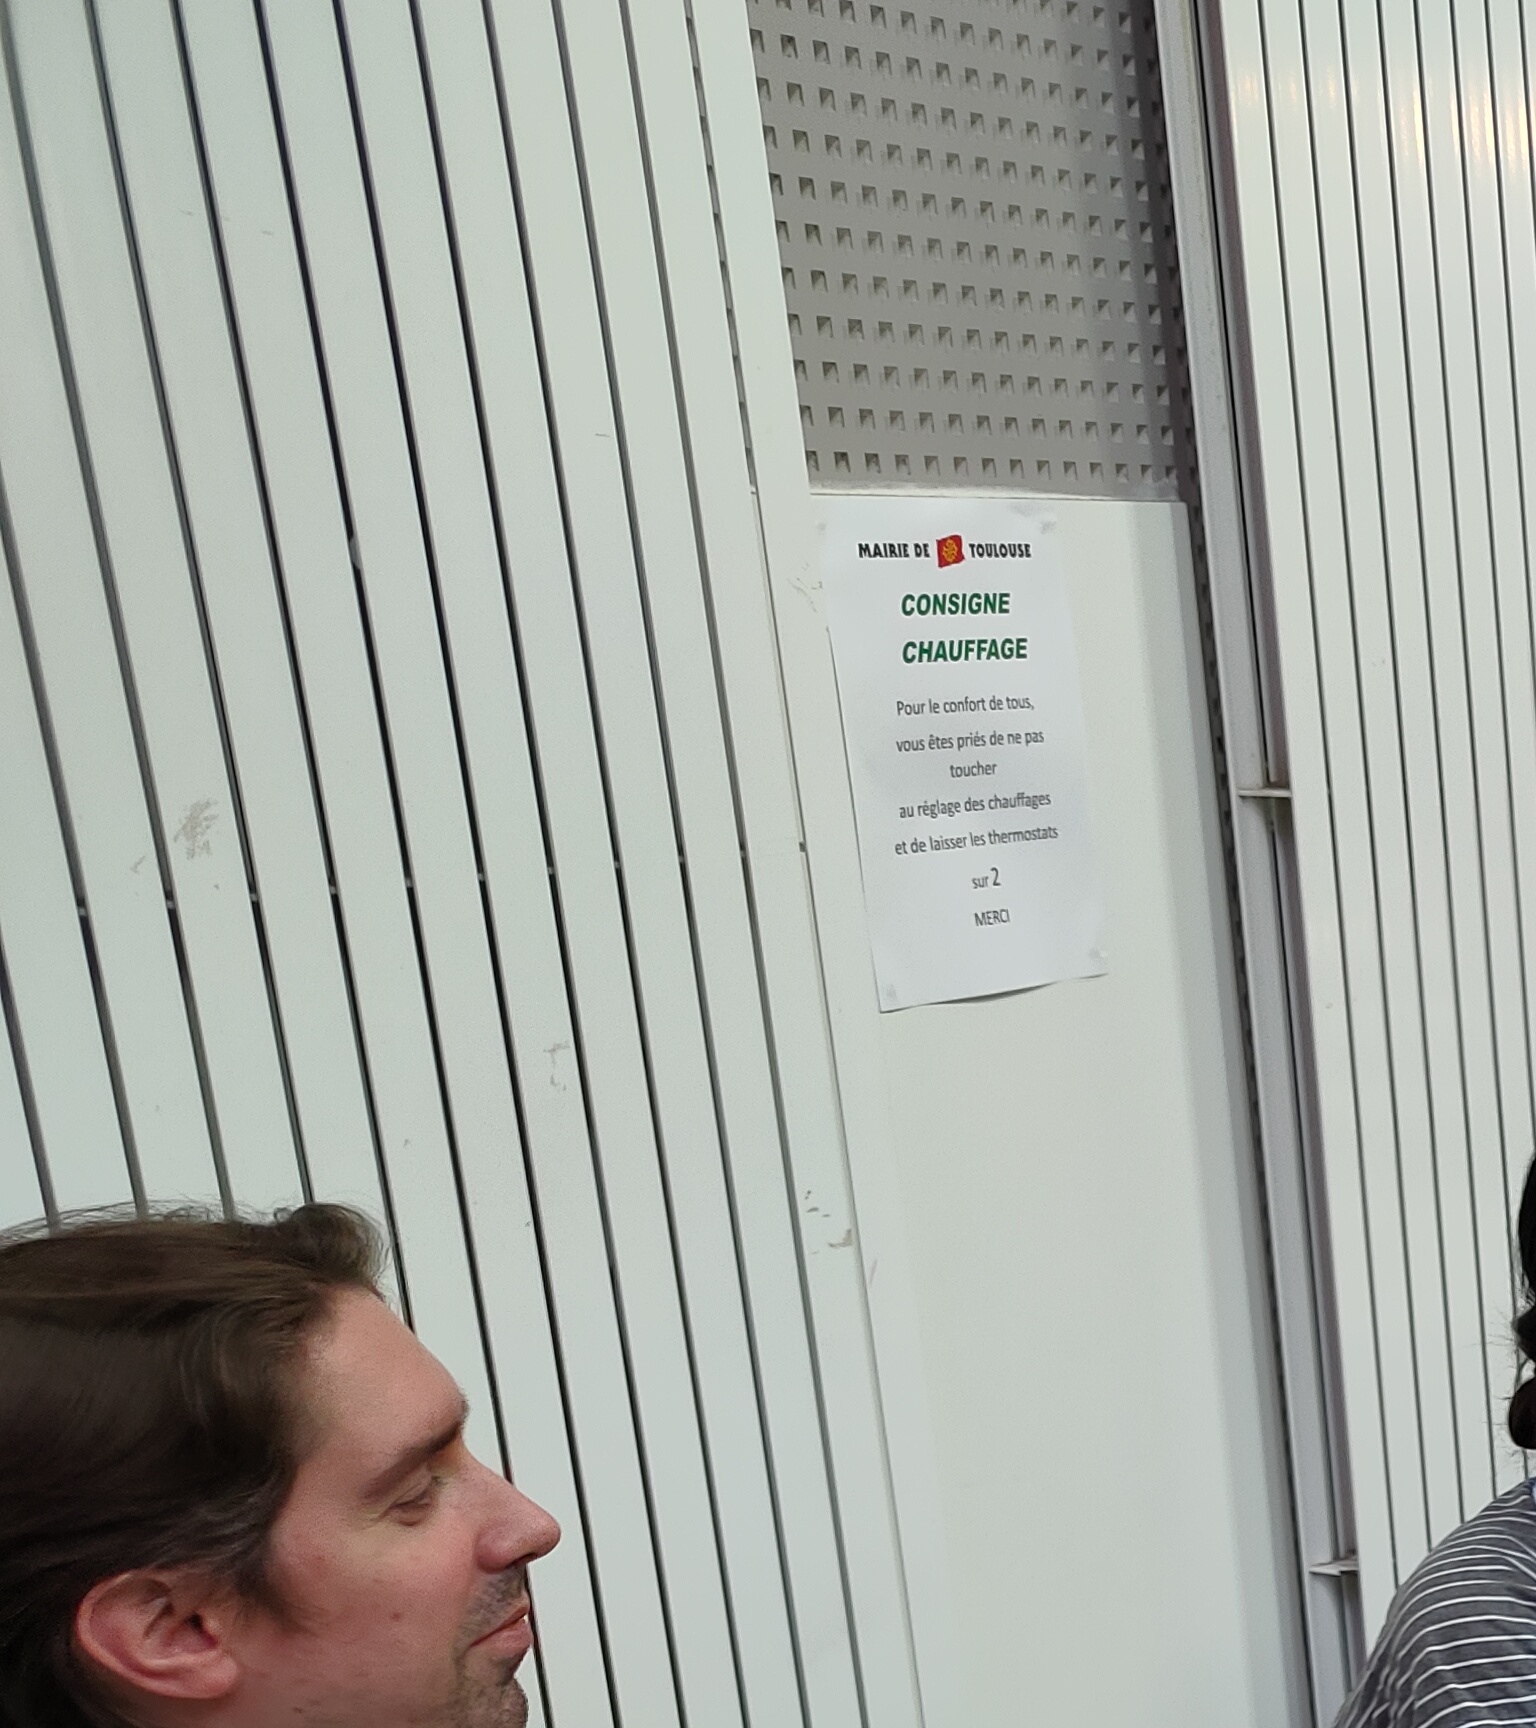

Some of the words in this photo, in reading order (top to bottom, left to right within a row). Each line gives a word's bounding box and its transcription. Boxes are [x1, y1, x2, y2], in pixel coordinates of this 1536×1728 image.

[858, 543, 909, 558] MAIRIE
[915, 543, 930, 558] DE
[969, 543, 1031, 558] TOULOUSE
[901, 592, 1010, 616] CONSIGNE
[902, 638, 1028, 664] CHAUFFAGE
[896, 700, 925, 716] Pour
[929, 698, 940, 714] le
[943, 696, 986, 713] confort
[989, 695, 1003, 711] de
[1006, 696, 1035, 710] tous,
[896, 738, 925, 752] vous
[928, 734, 954, 750] êtes
[957, 731, 986, 751] priés
[989, 730, 1004, 746] de
[1007, 732, 1022, 745] ne
[1024, 731, 1044, 746] pas
[950, 761, 998, 778] toucher
[899, 806, 914, 818] au
[918, 799, 961, 819] réglage
[965, 797, 985, 812] des
[988, 792, 1052, 809] chauffages
[895, 841, 908, 855] et
[910, 837, 927, 853] de
[929, 835, 967, 851] laisser
[970, 832, 986, 847] les
[988, 826, 1058, 845] thermostats
[971, 876, 989, 889] sur
[990, 867, 1001, 886] 2
[974, 908, 1010, 927] MERCI
